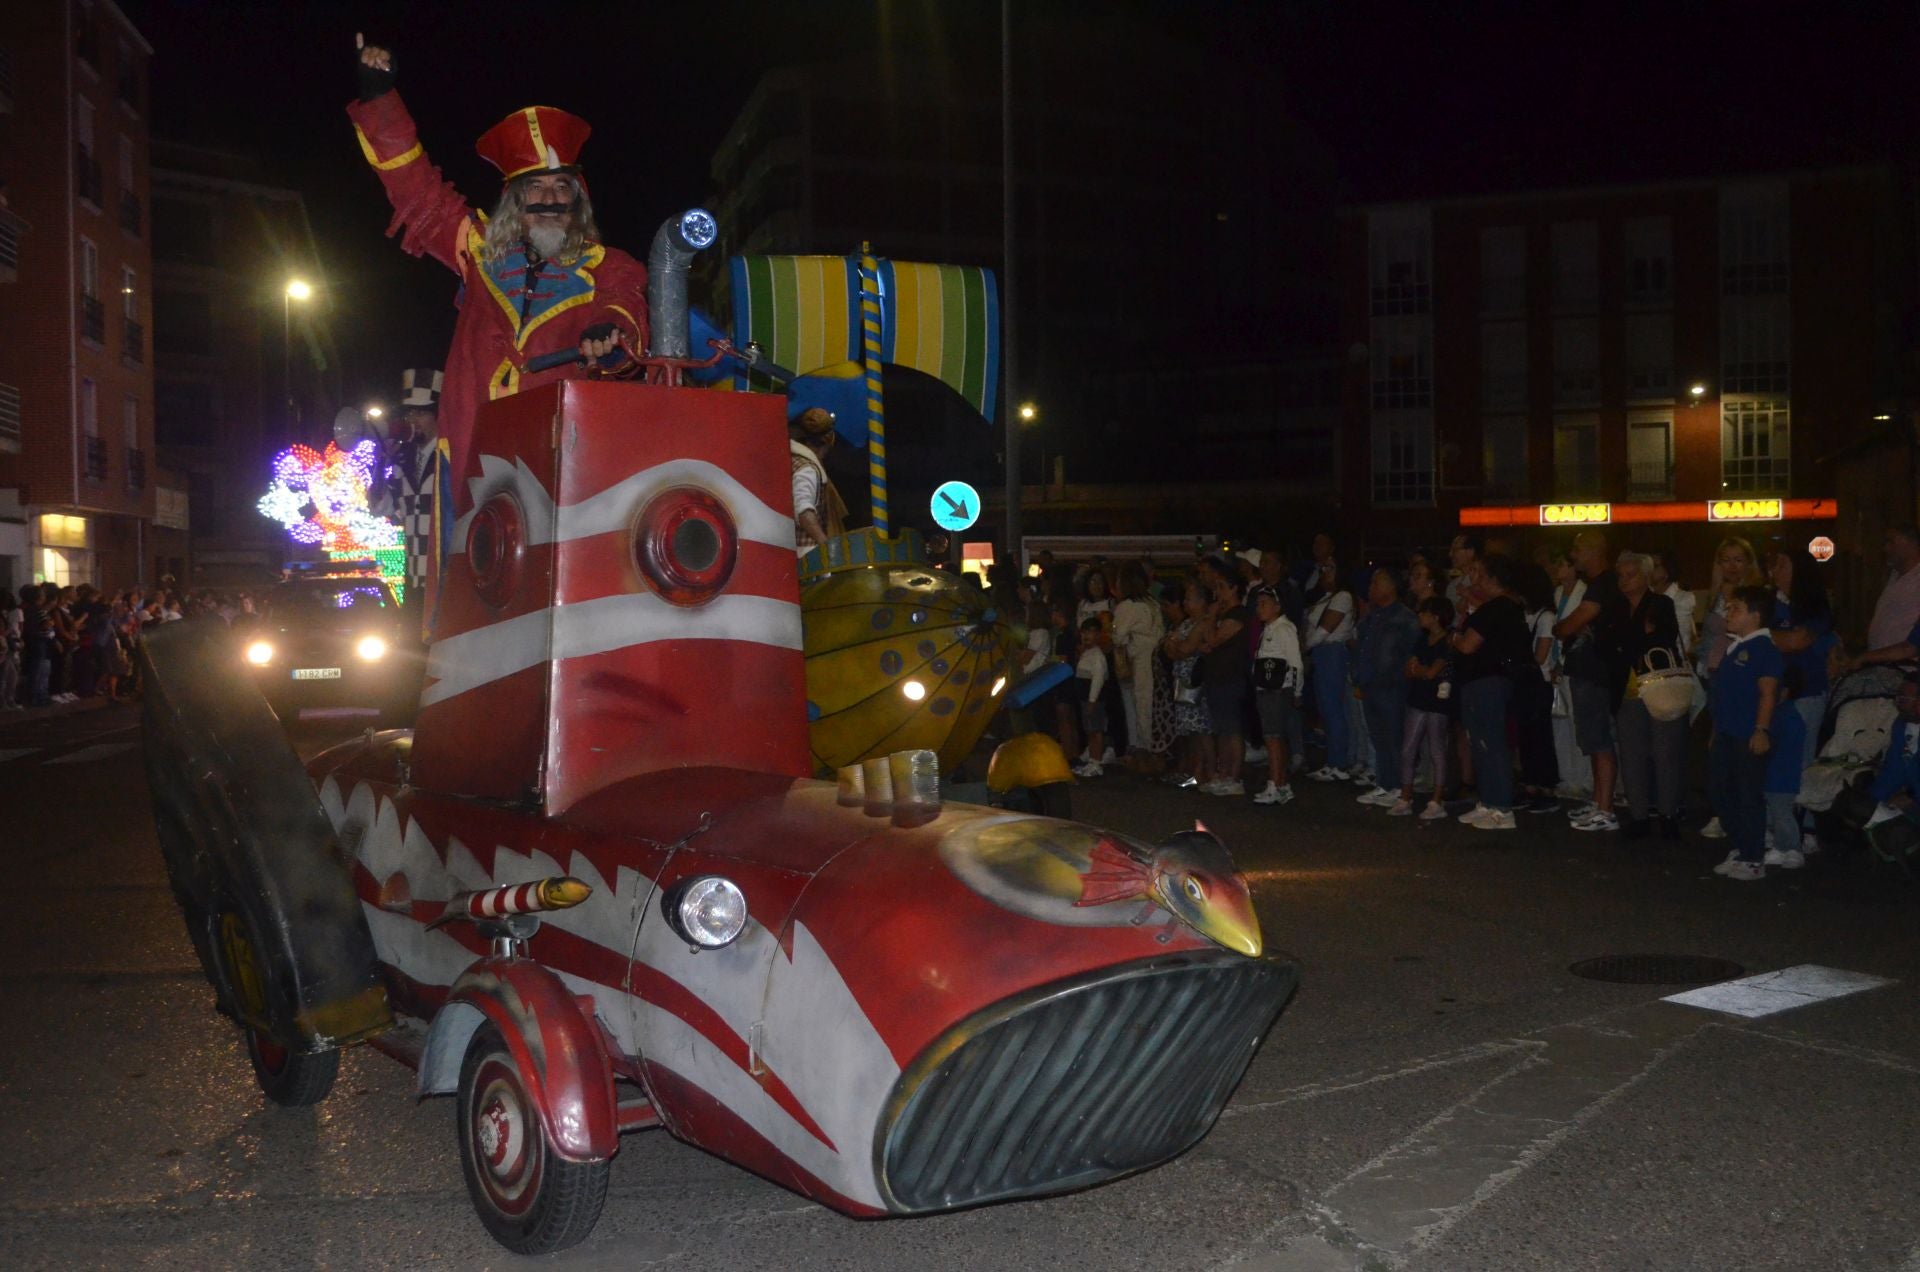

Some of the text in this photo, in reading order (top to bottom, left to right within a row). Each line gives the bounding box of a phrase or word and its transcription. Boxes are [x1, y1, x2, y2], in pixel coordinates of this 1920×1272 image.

[1545, 504, 1607, 522] GADIS
[1713, 501, 1779, 518] GADIS
[1812, 545, 1831, 553] STOP
